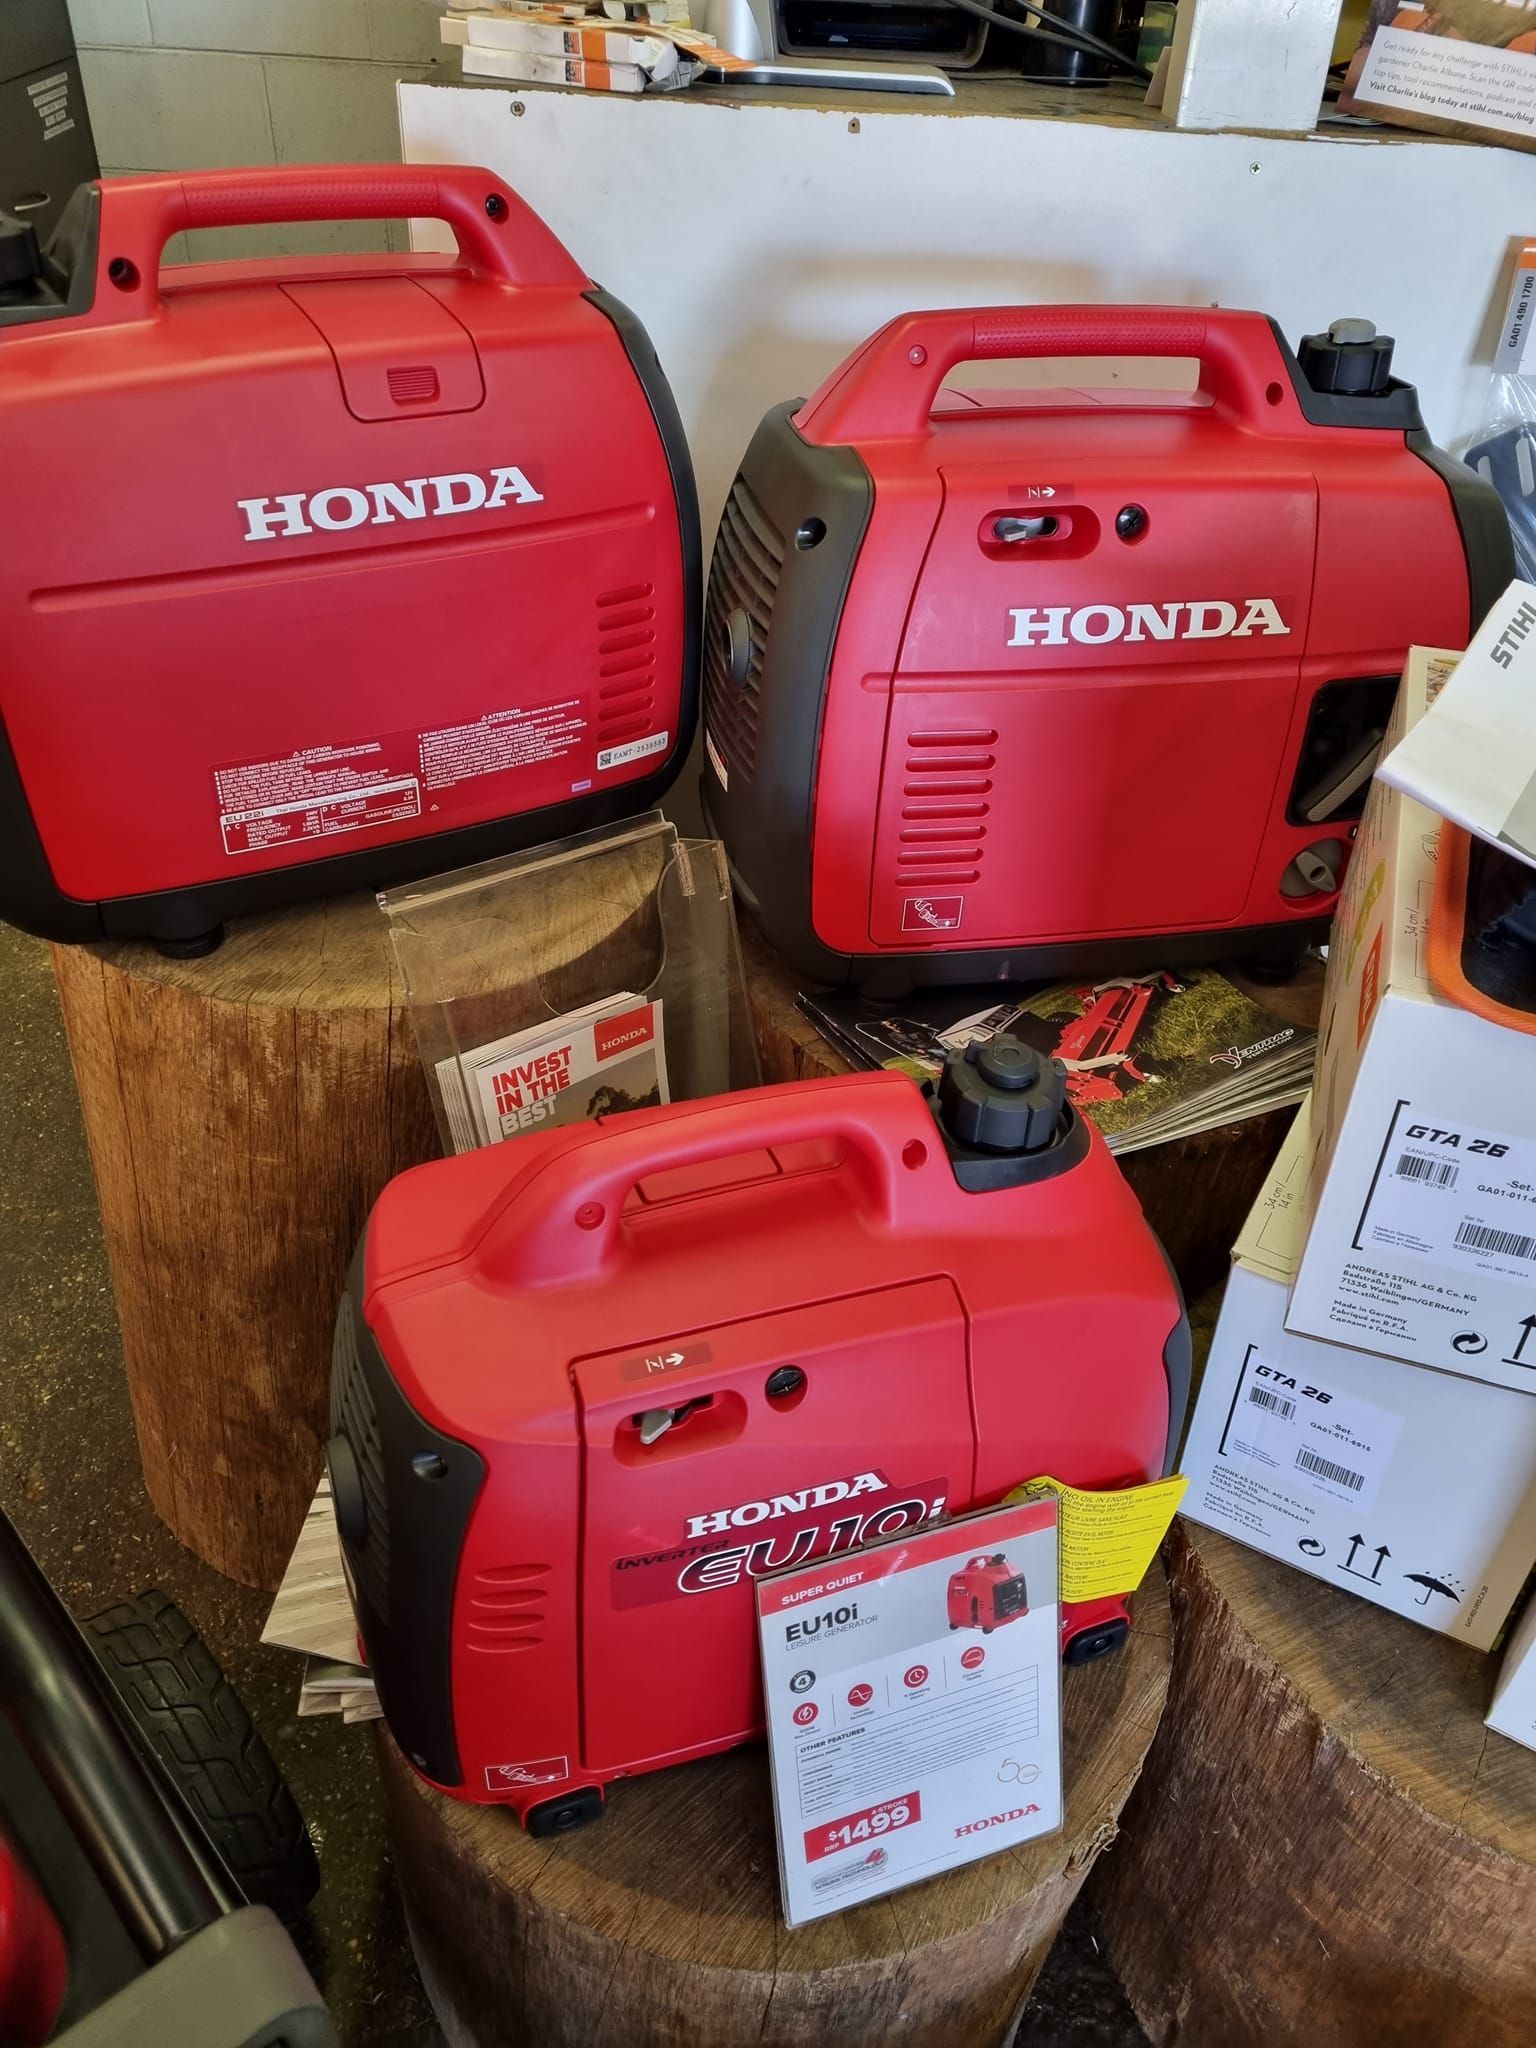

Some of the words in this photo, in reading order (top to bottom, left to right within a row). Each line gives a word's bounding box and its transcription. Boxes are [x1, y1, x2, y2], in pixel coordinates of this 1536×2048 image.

[1383, 40, 1397, 50] Get
[1398, 43, 1419, 54] ready
[1420, 47, 1431, 57] for
[1432, 50, 1445, 60] any
[1446, 53, 1482, 67] challenge
[1484, 61, 1499, 71] with
[1378, 54, 1411, 69] gardener
[1412, 61, 1438, 74] Charlie
[1469, 73, 1487, 84] Scan
[1488, 77, 1500, 87] the
[1502, 79, 1515, 90] QR
[1370, 81, 1385, 91] Visit
[1387, 85, 1418, 98] Charlie's
[1420, 91, 1436, 101] blog
[1438, 95, 1459, 106] today
[1460, 100, 1468, 108] at
[1469, 103, 1534, 124] stihl.com.au/blog
[1373, 68, 1386, 77] top
[1403, 74, 1417, 84] tool
[1486, 91, 1516, 105] podcast
[1517, 98, 1531, 108] and
[1508, 323, 1522, 348] GA01
[1516, 302, 1528, 321] 490
[1522, 276, 1535, 299] 1700
[238, 467, 544, 541] HONDA
[1006, 598, 1291, 647] HONDA
[488, 708, 521, 719] ATTENTION
[302, 745, 332, 755] CAUTION
[226, 811, 264, 822] EU22i
[340, 800, 366, 809] VOLTAGE
[341, 805, 367, 814] CURRENT
[246, 819, 273, 828] VOLTAGE
[247, 822, 281, 832] FREQUENCY
[248, 830, 267, 838] RATED
[269, 825, 291, 834] OUTPUT
[267, 831, 288, 839] OUTPUT
[601, 1027, 647, 1050] HONDA
[491, 1045, 572, 1096] INVEST
[496, 1091, 524, 1115] IN
[527, 1068, 571, 1102] THE
[501, 1096, 557, 1136] BEST
[1405, 1124, 1461, 1148] GTA
[1466, 1138, 1510, 1158] 26
[1506, 1180, 1535, 1191] -Set-
[1339, 1285, 1399, 1305] www.stihl.com
[1345, 1263, 1389, 1278] ANDREAS
[1392, 1275, 1418, 1286] STIHL
[1421, 1282, 1434, 1290] AG
[1446, 1289, 1461, 1297] Co.
[1389, 1282, 1402, 1290] 115
[1334, 1300, 1356, 1309] Made
[1369, 1309, 1408, 1324] Germany
[1370, 1285, 1470, 1316] Waiblingen/GERMANY
[1331, 1307, 1368, 1321] Fabriqué
[1383, 1320, 1409, 1331] R.F.A.
[1254, 1365, 1297, 1389] GTA
[1301, 1385, 1333, 1405] 26
[1214, 1464, 1248, 1483] ANDREAS
[1250, 1480, 1270, 1493] STIHL
[686, 1472, 887, 1539] HONDA
[1064, 1490, 1078, 1500] NO
[782, 1583, 824, 1606] SUPER
[826, 1571, 864, 1591] QUIET
[785, 1602, 859, 1642] EU10i
[785, 1633, 822, 1652] LEISURE
[824, 1615, 879, 1640] GENERATOR
[800, 1739, 826, 1753] OTHER
[828, 1727, 865, 1745] FEATURES
[828, 1805, 910, 1845] $1499
[955, 1803, 1041, 1839] HONDA
